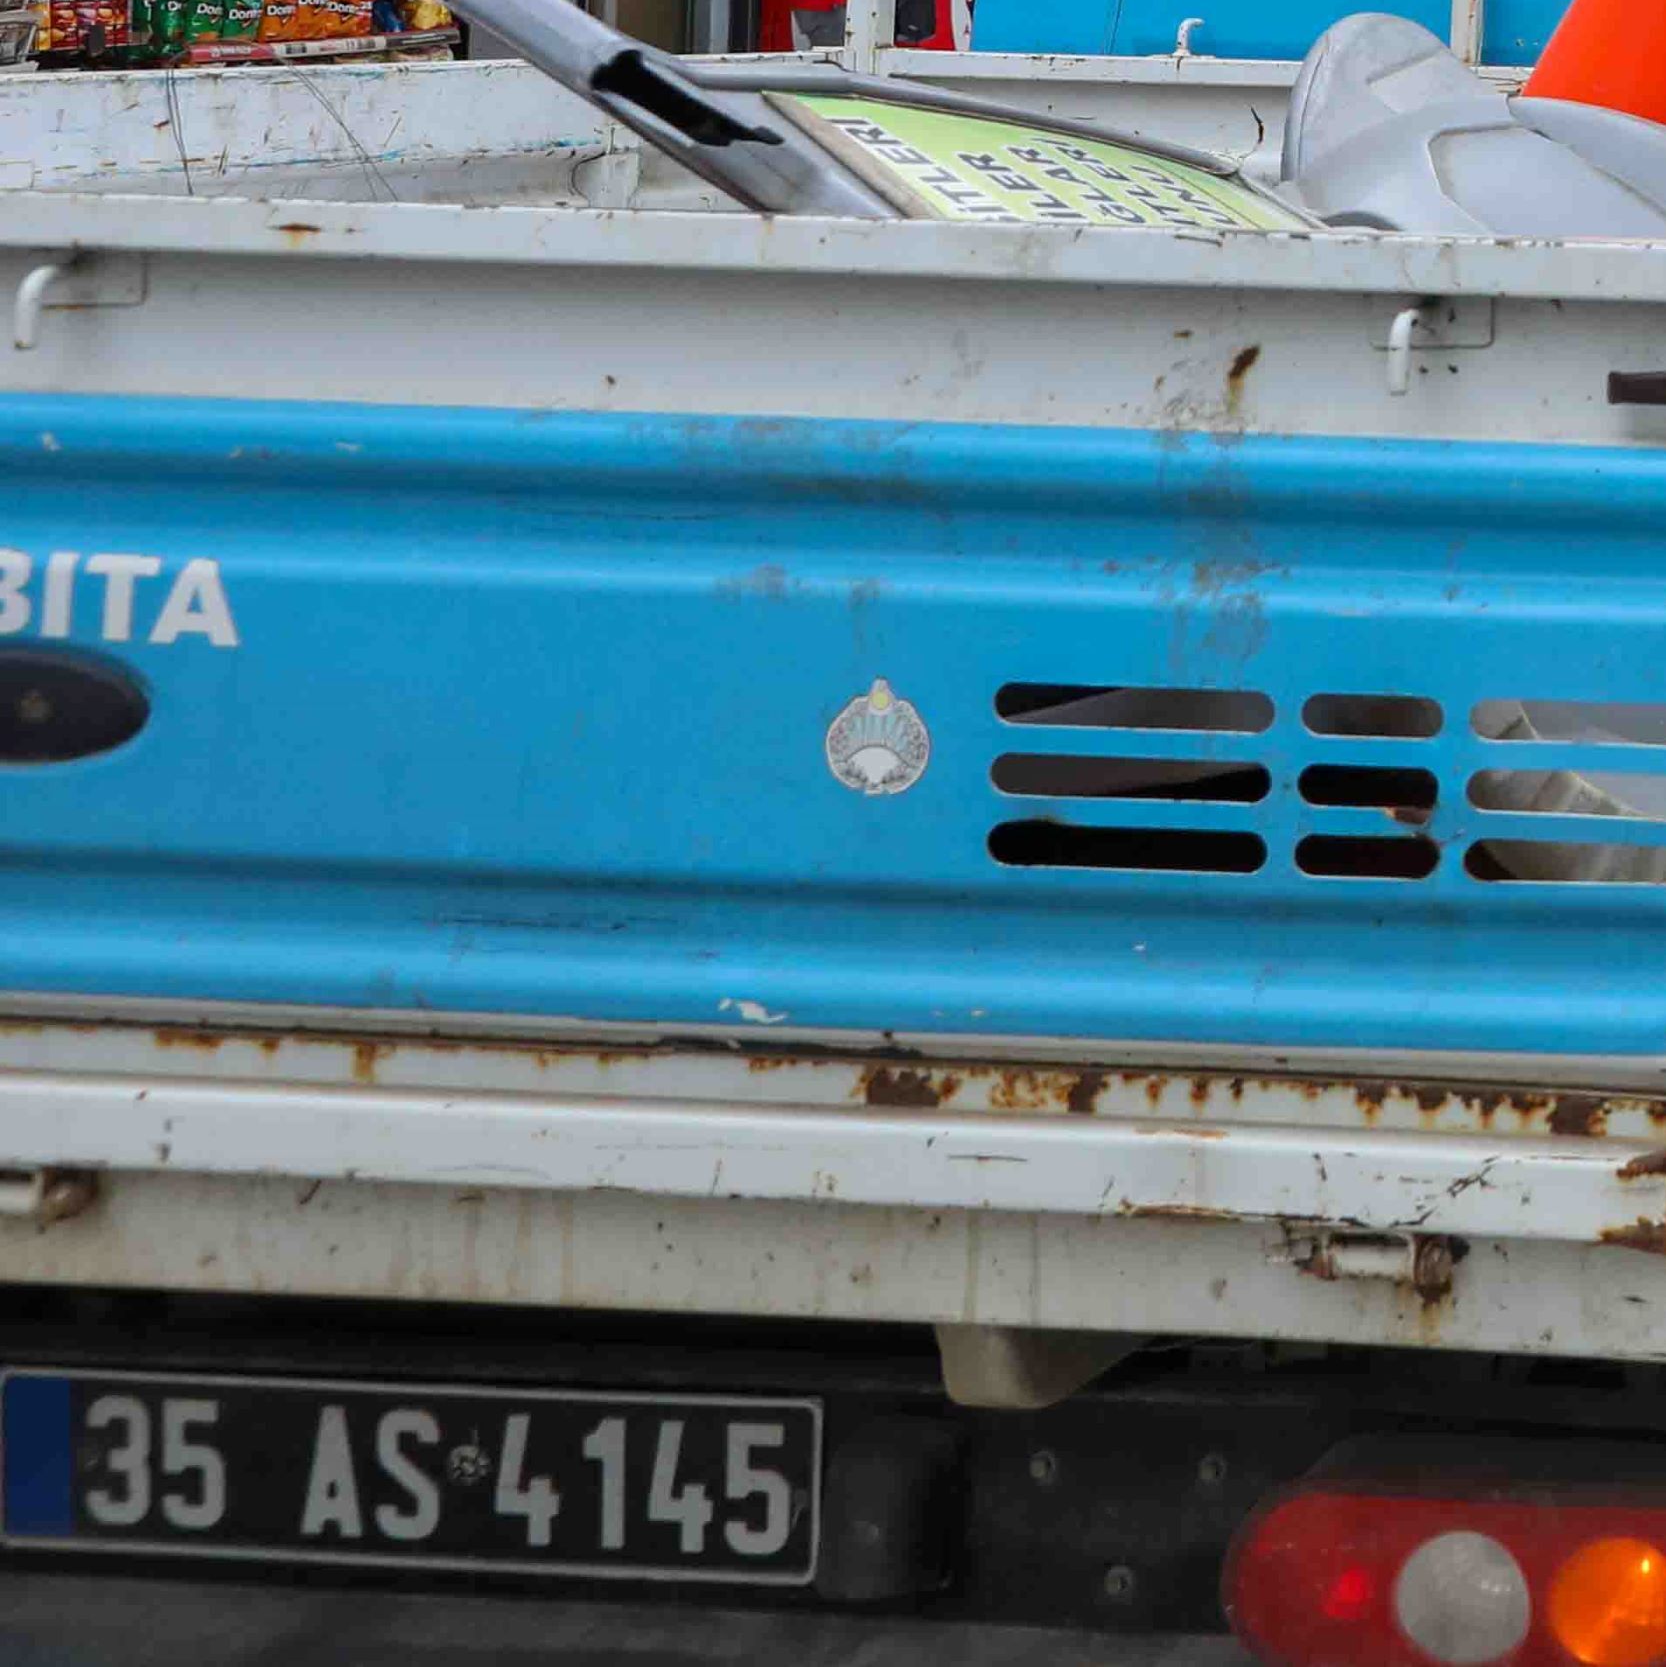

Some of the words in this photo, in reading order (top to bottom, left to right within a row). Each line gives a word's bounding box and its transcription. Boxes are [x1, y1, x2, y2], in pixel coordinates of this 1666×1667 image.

[83, 1394, 227, 1530] 35
[300, 1404, 442, 1540] AS
[494, 1412, 795, 1556] 4145
